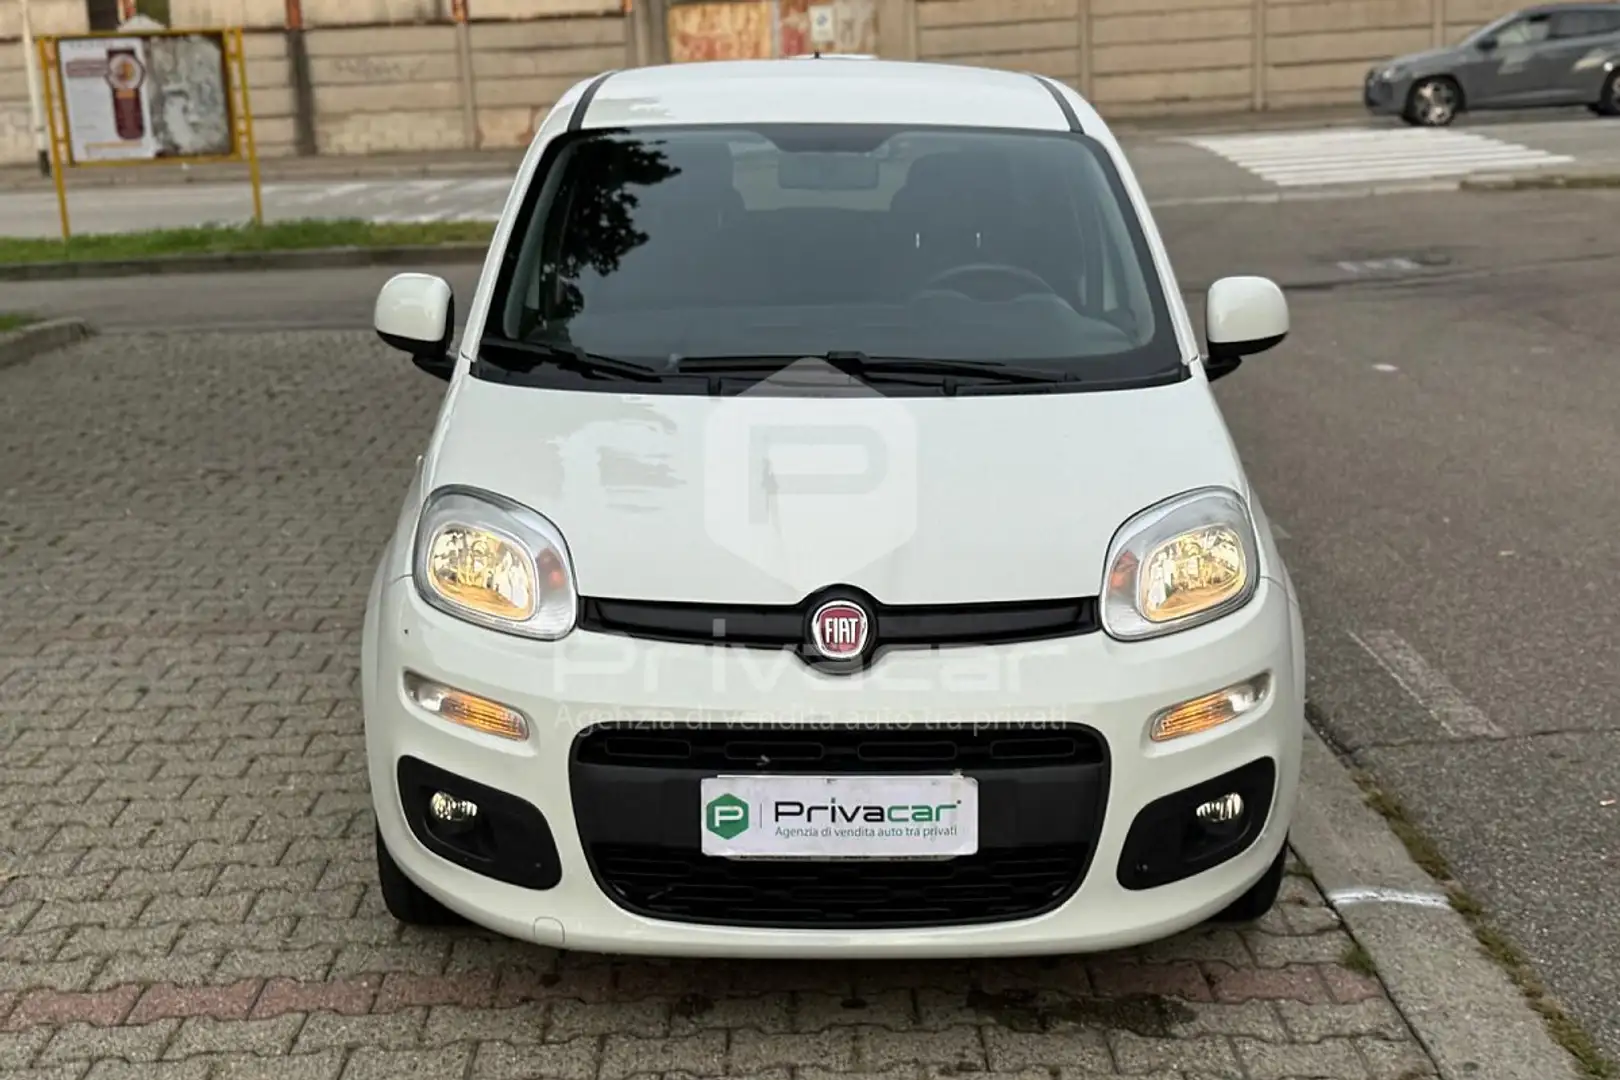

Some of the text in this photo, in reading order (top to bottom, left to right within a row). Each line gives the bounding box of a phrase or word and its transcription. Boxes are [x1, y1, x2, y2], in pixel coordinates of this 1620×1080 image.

[824, 617, 860, 644] FIAT
[774, 797, 957, 823] Privacar
[774, 825, 957, 839] Agenzia di vendita auto tra privati
